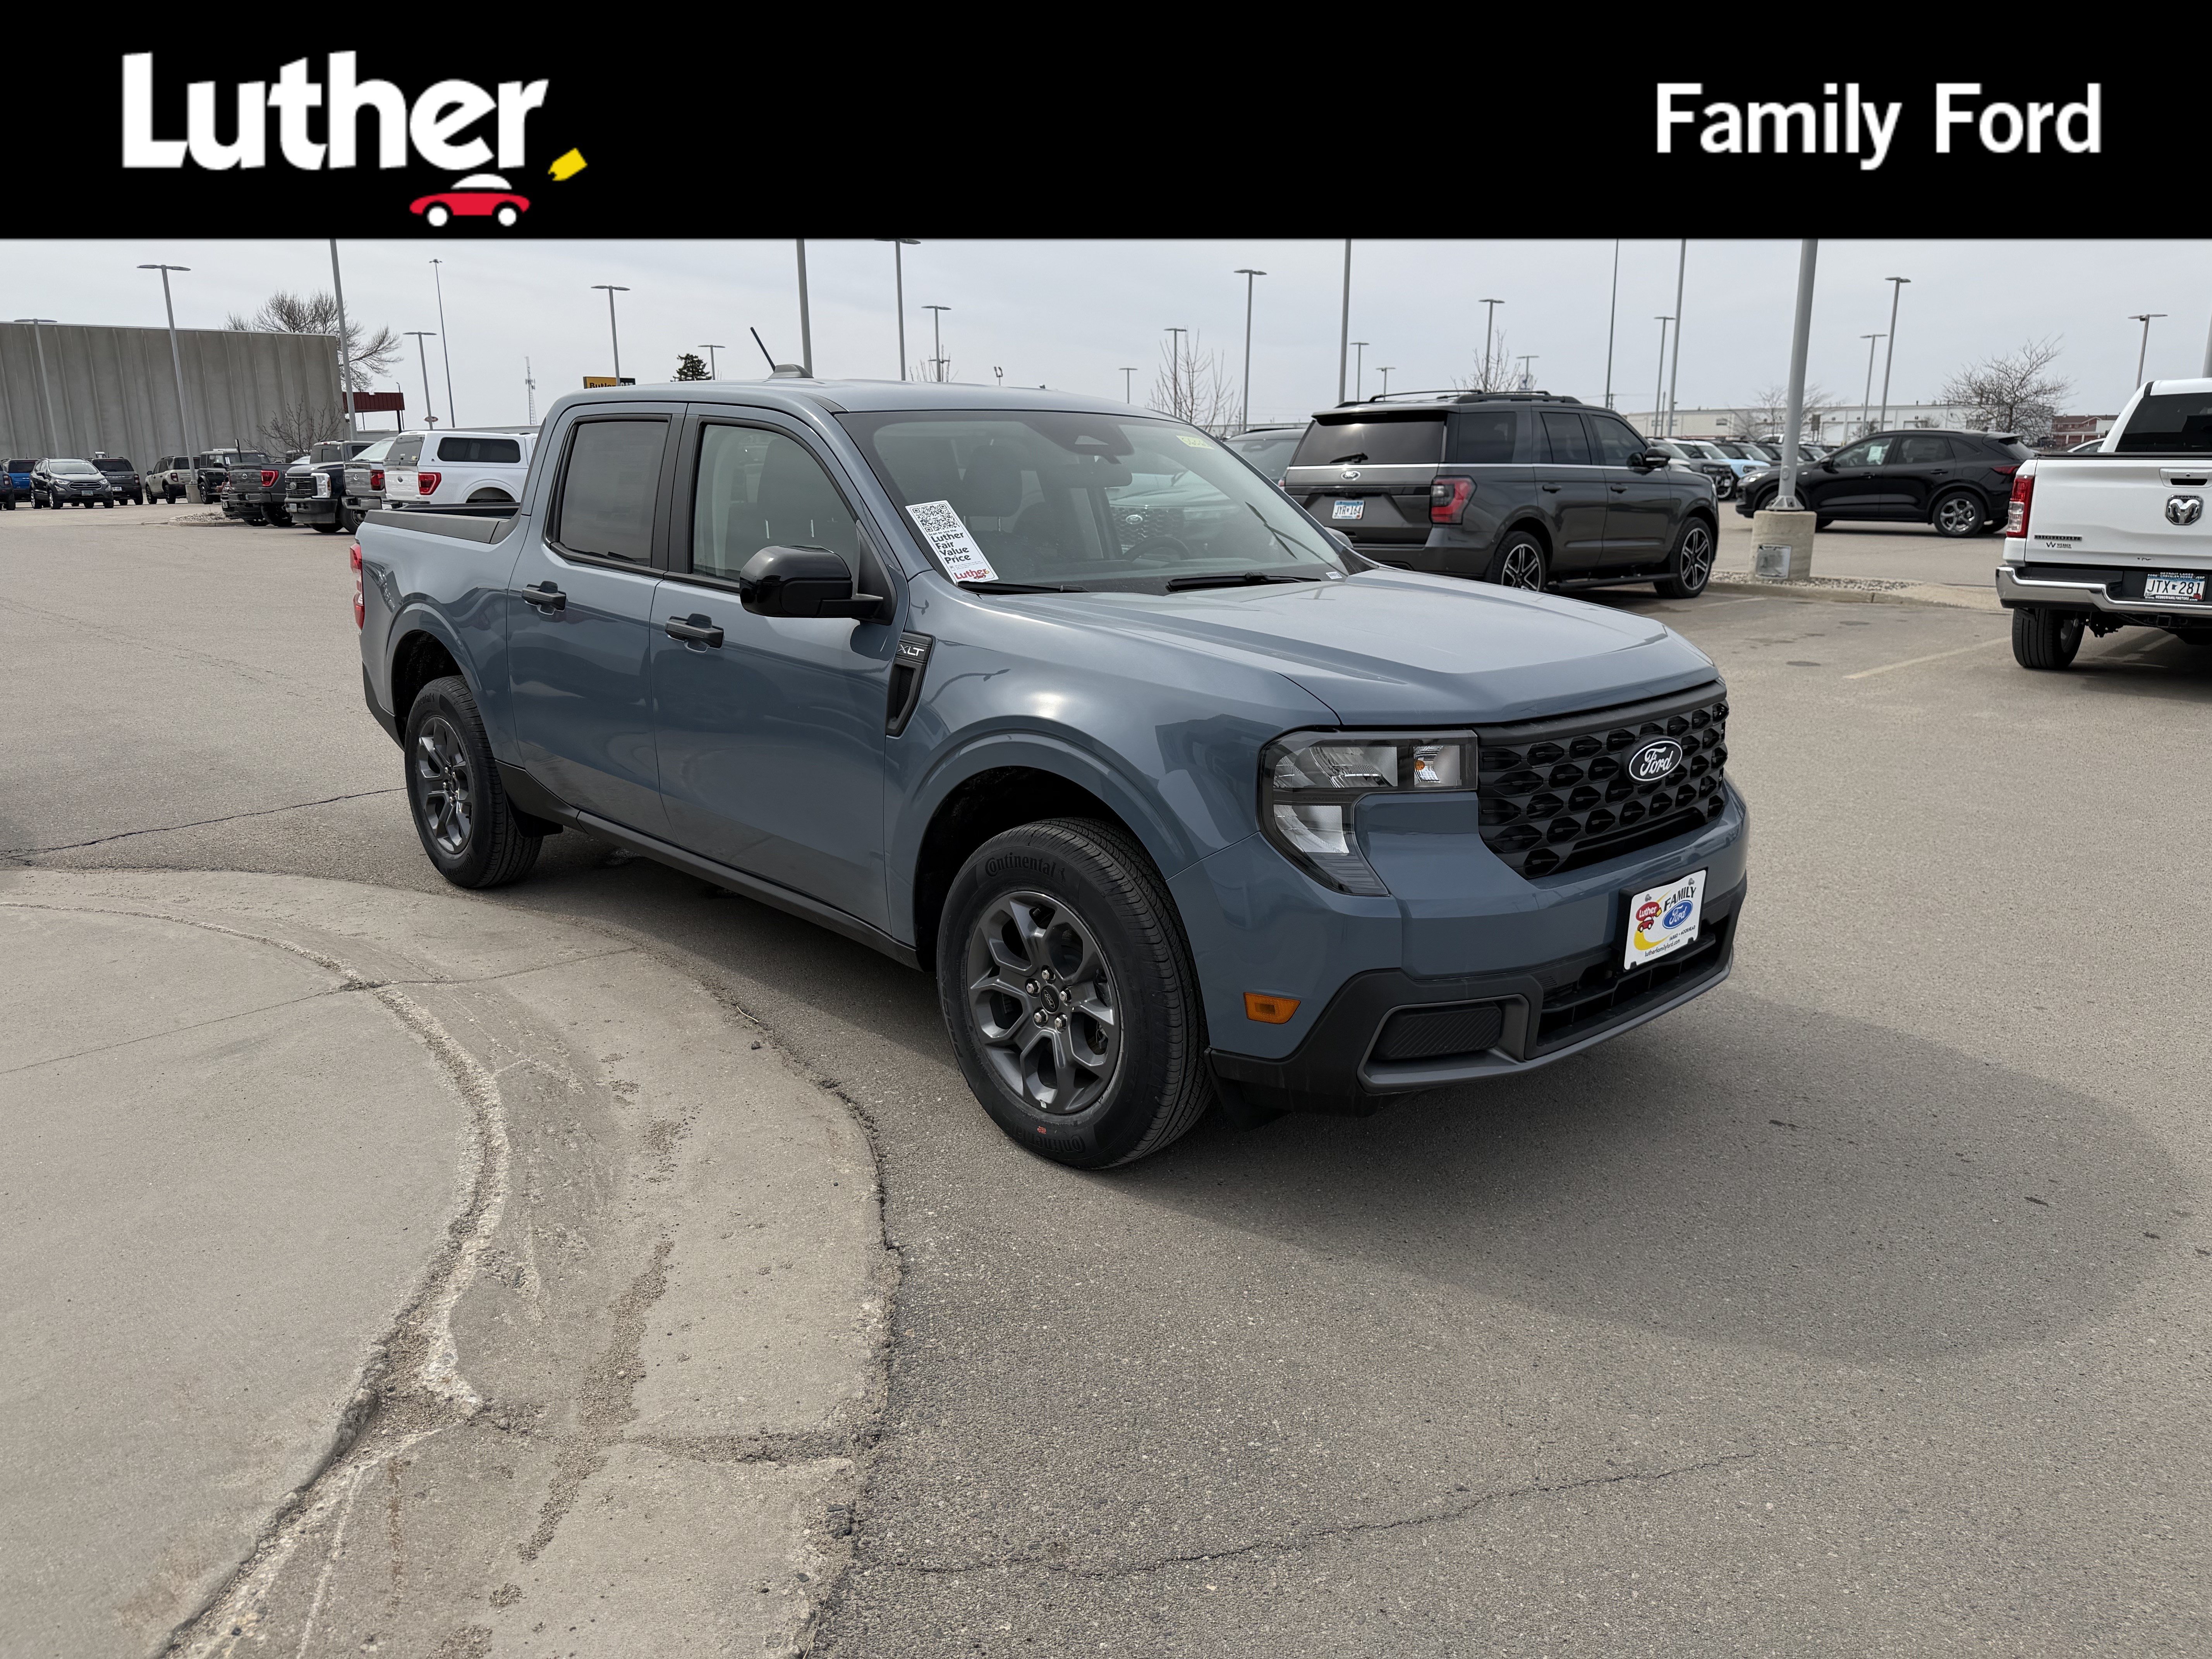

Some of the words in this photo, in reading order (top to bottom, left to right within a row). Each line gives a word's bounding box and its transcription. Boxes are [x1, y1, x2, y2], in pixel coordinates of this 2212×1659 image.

[931, 532, 964, 543] Luther
[935, 541, 954, 550] Fair
[939, 547, 969, 556] Value
[944, 555, 971, 564] Price
[953, 568, 987, 580] Luther
[2147, 580, 2171, 593] JTX
[2178, 581, 2200, 594] 281
[897, 644, 925, 656] XLT
[1640, 746, 1674, 776] Ford
[985, 852, 1056, 878] Continental
[1663, 886, 1697, 912] FAMILY
[1638, 906, 1657, 918] Luther
[1669, 905, 1686, 925] Ford
[1044, 993, 1053, 1005] Ford
